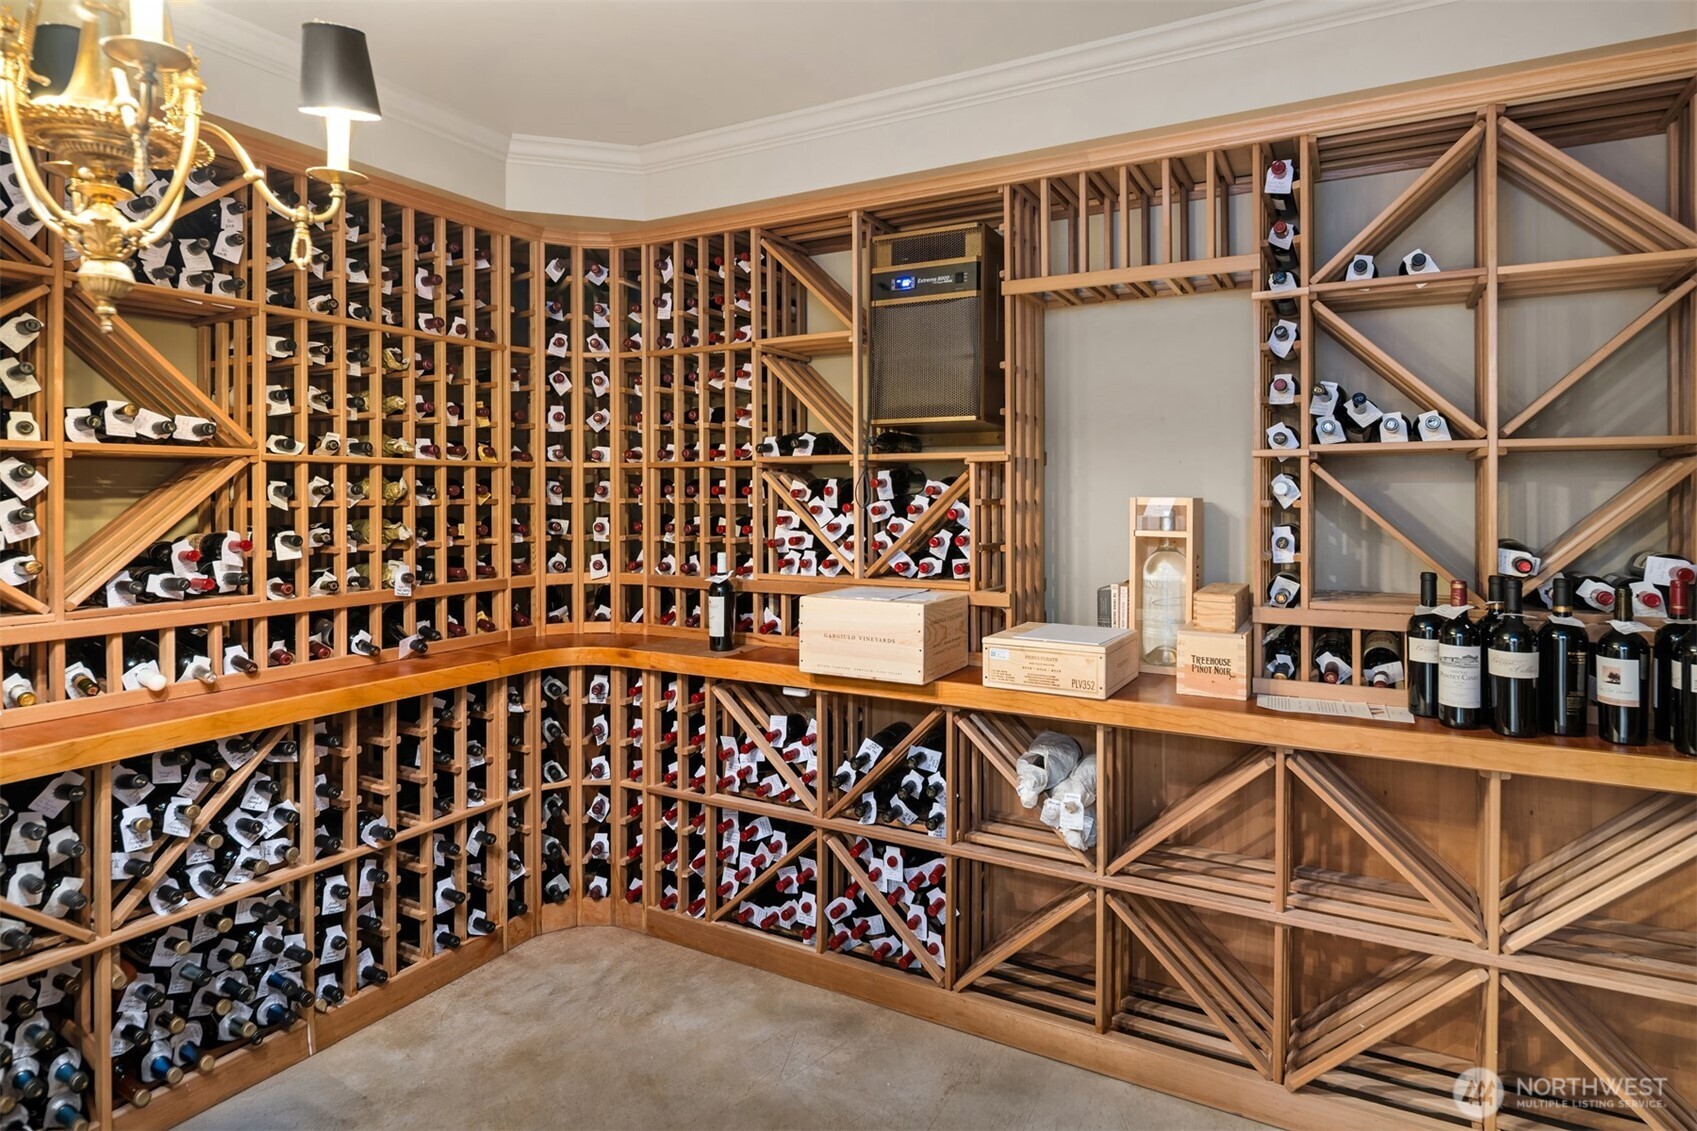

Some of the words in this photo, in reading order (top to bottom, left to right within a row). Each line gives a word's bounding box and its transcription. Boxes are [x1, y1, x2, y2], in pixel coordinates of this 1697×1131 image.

[823, 632, 856, 641] GARGIULO
[858, 635, 896, 644] VINEYARDS
[1190, 654, 1232, 667] TREEHOUSE
[1191, 664, 1212, 674] PINOT
[1213, 665, 1236, 680] NOIR
[1071, 678, 1095, 691] PLV352
